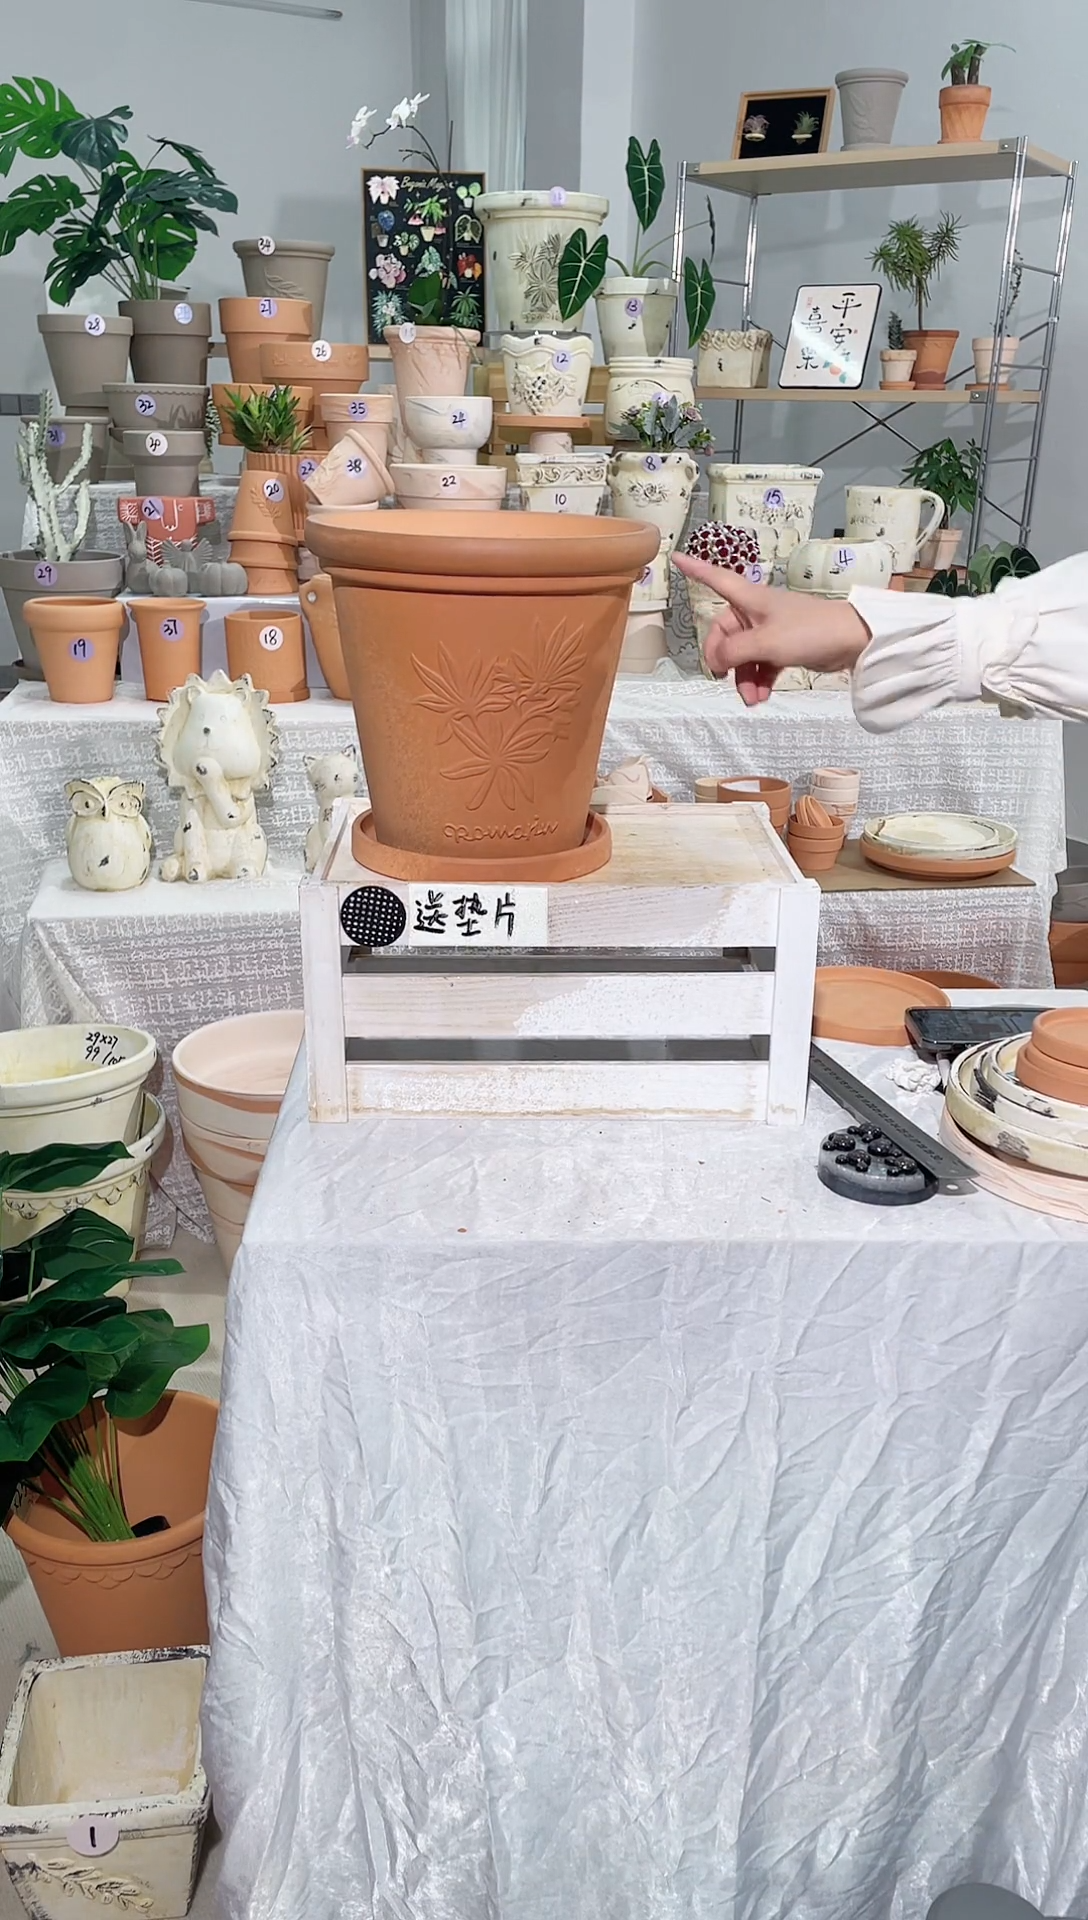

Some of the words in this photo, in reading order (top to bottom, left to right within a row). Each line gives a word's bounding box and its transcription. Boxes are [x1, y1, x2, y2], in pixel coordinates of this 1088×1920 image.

[261, 299, 271, 315] 27
[627, 300, 639, 313] 13
[87, 317, 99, 331] 28
[315, 345, 328, 358] 26
[556, 353, 568, 363] 12
[138, 399, 154, 413] 32
[350, 402, 365, 415] 35
[347, 458, 362, 473] 38
[644, 455, 656, 471] 8
[441, 474, 456, 488] 22
[266, 482, 281, 497] 20
[765, 489, 780, 505] 15
[555, 493, 567, 506] 10
[839, 549, 853, 566] 4
[37, 565, 51, 584] 29
[750, 564, 763, 583] 5
[163, 619, 177, 636] 37
[264, 629, 277, 647] 18
[74, 637, 87, 659] 19
[413, 889, 516, 937] 送垫片
[90, 1825, 97, 1848] 1
